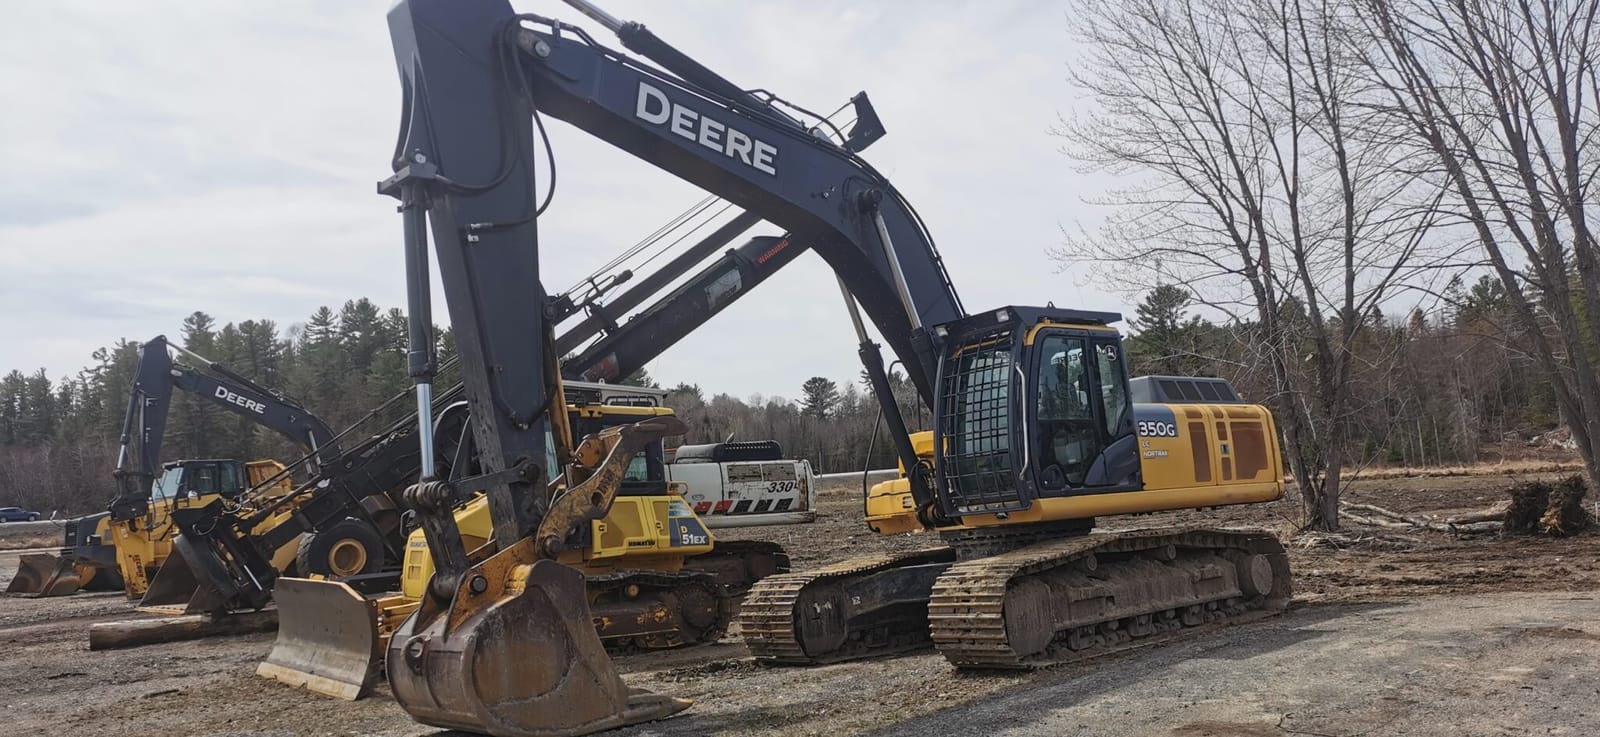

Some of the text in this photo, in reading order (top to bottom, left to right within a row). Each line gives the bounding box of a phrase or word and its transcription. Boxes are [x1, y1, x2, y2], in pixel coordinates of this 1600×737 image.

[636, 81, 778, 176] DEERE
[214, 385, 267, 415] DEERE
[1138, 421, 1175, 436] 350G
[680, 525, 689, 534] D
[682, 533, 707, 545] 51EX
